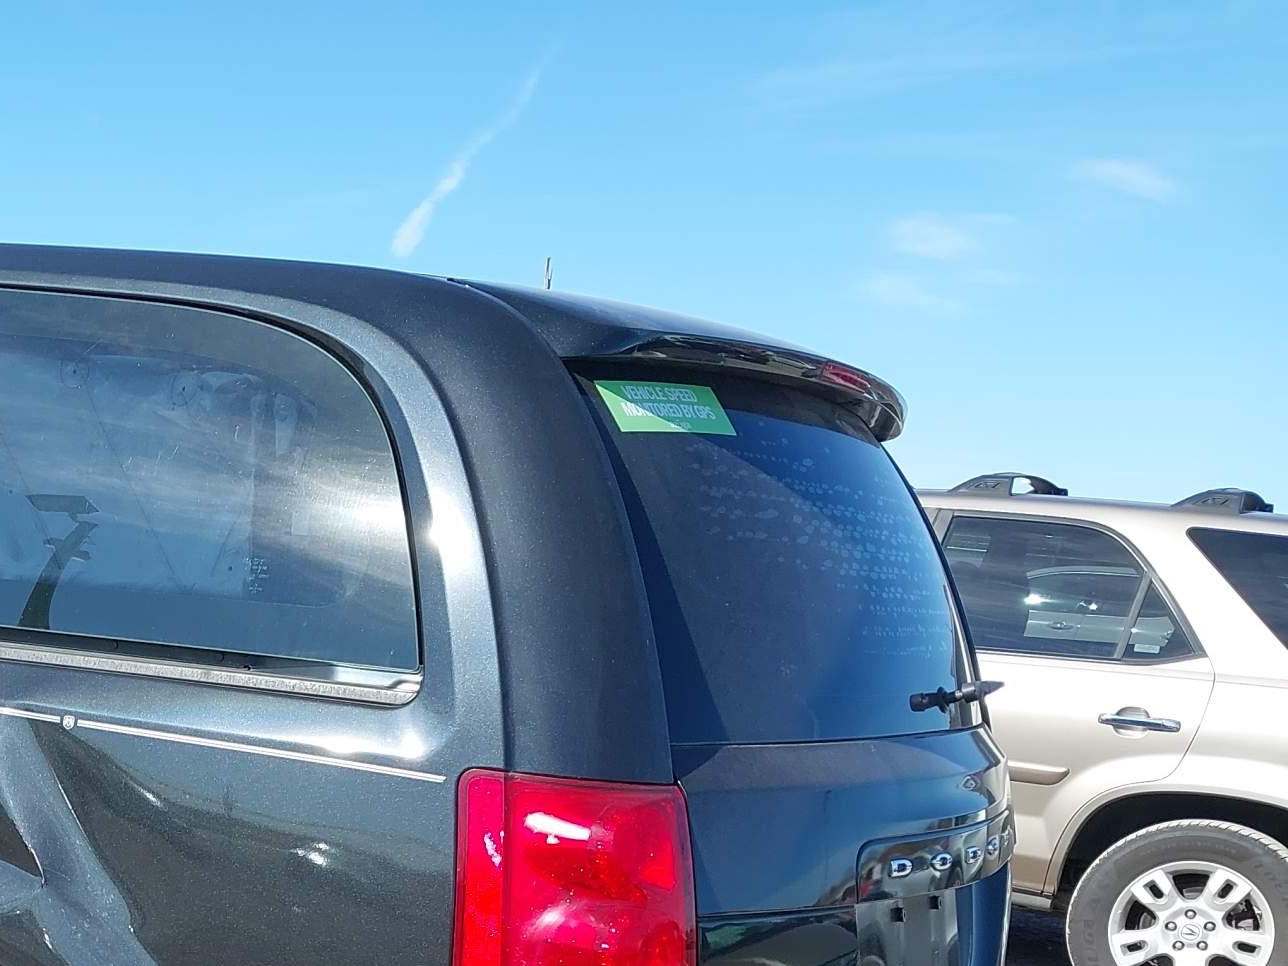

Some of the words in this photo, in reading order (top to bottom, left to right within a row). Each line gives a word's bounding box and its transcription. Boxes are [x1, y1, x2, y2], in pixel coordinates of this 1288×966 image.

[620, 385, 668, 401] VEHICLE
[664, 387, 697, 402] SPEED
[620, 402, 682, 417] MONITORED
[693, 405, 716, 419] GPS
